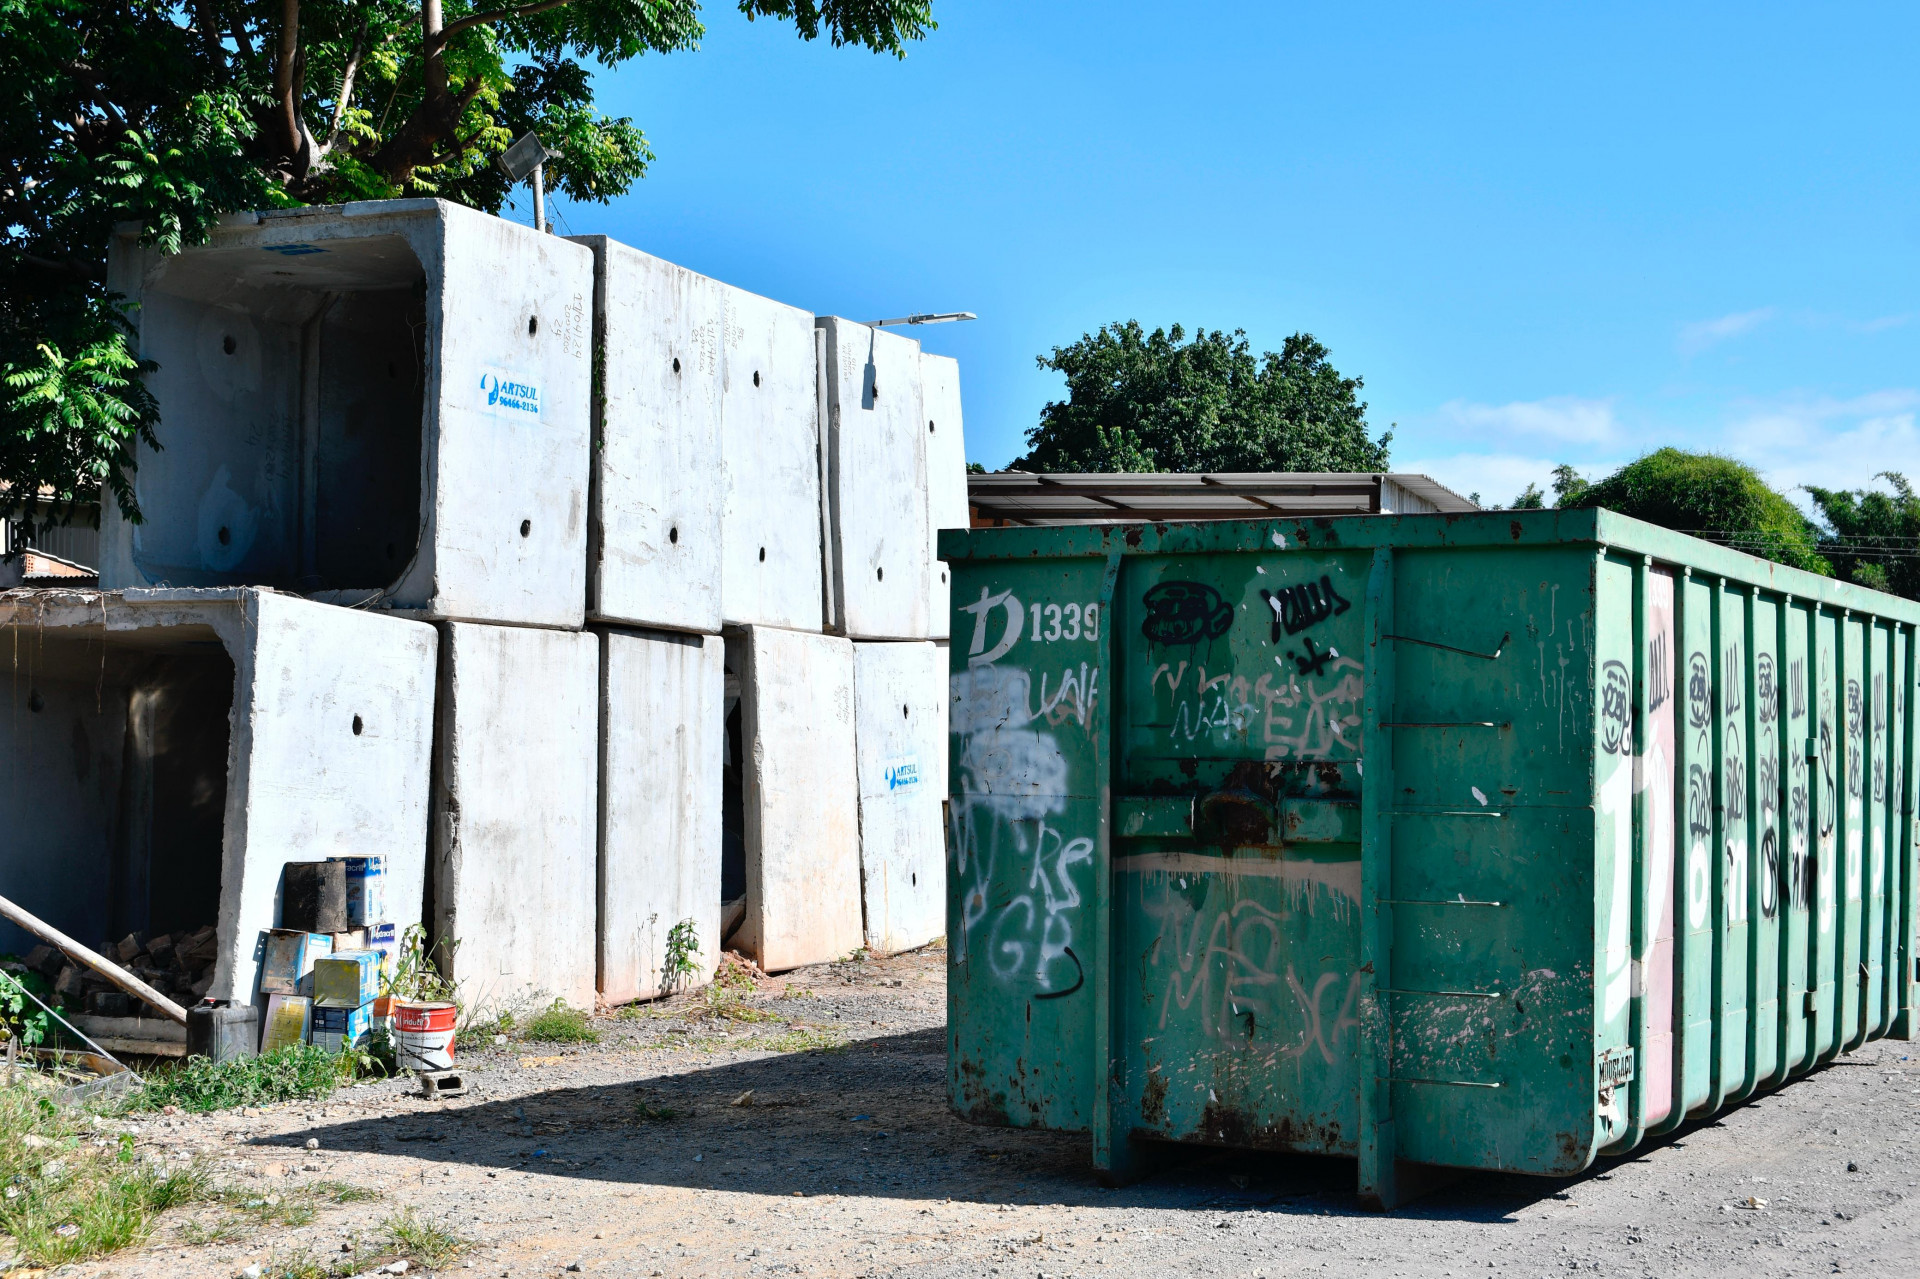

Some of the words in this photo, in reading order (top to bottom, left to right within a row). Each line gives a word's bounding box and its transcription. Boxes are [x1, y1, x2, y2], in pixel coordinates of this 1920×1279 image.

[500, 381, 538, 401] ARTSUL
[1030, 603, 1098, 642] 1339
[896, 764, 917, 777] ARTSUL
